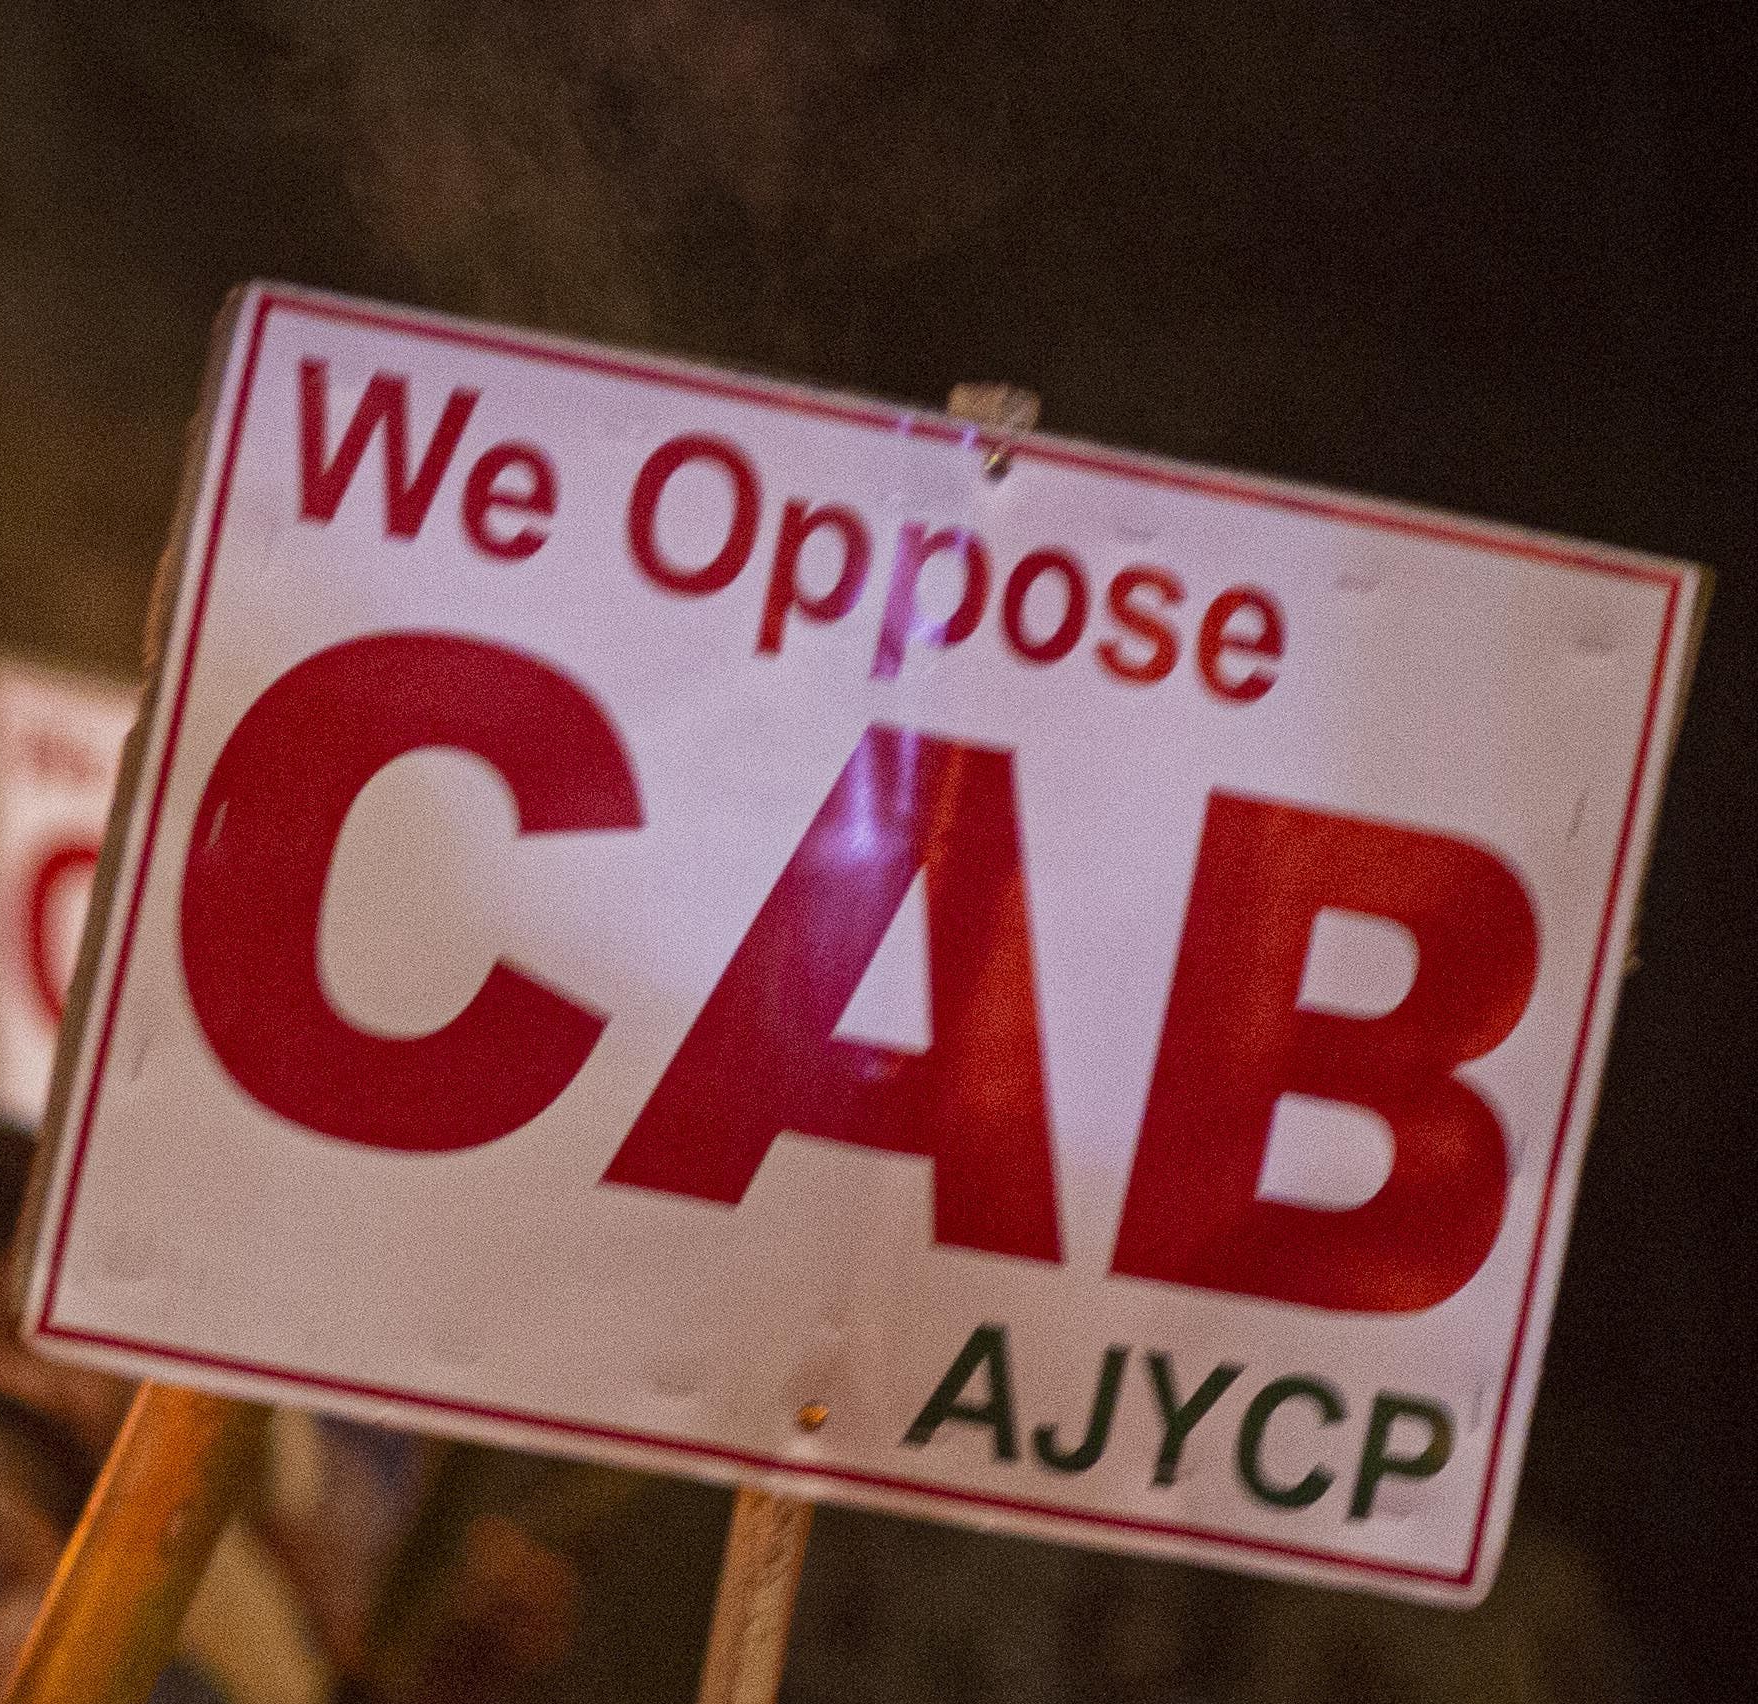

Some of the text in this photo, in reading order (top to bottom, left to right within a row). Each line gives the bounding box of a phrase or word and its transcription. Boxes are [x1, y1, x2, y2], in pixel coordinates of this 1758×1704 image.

[296, 354, 1287, 707] We Oppose
[176, 630, 1543, 1317] CAB
[899, 1320, 1456, 1523] AJYCP
